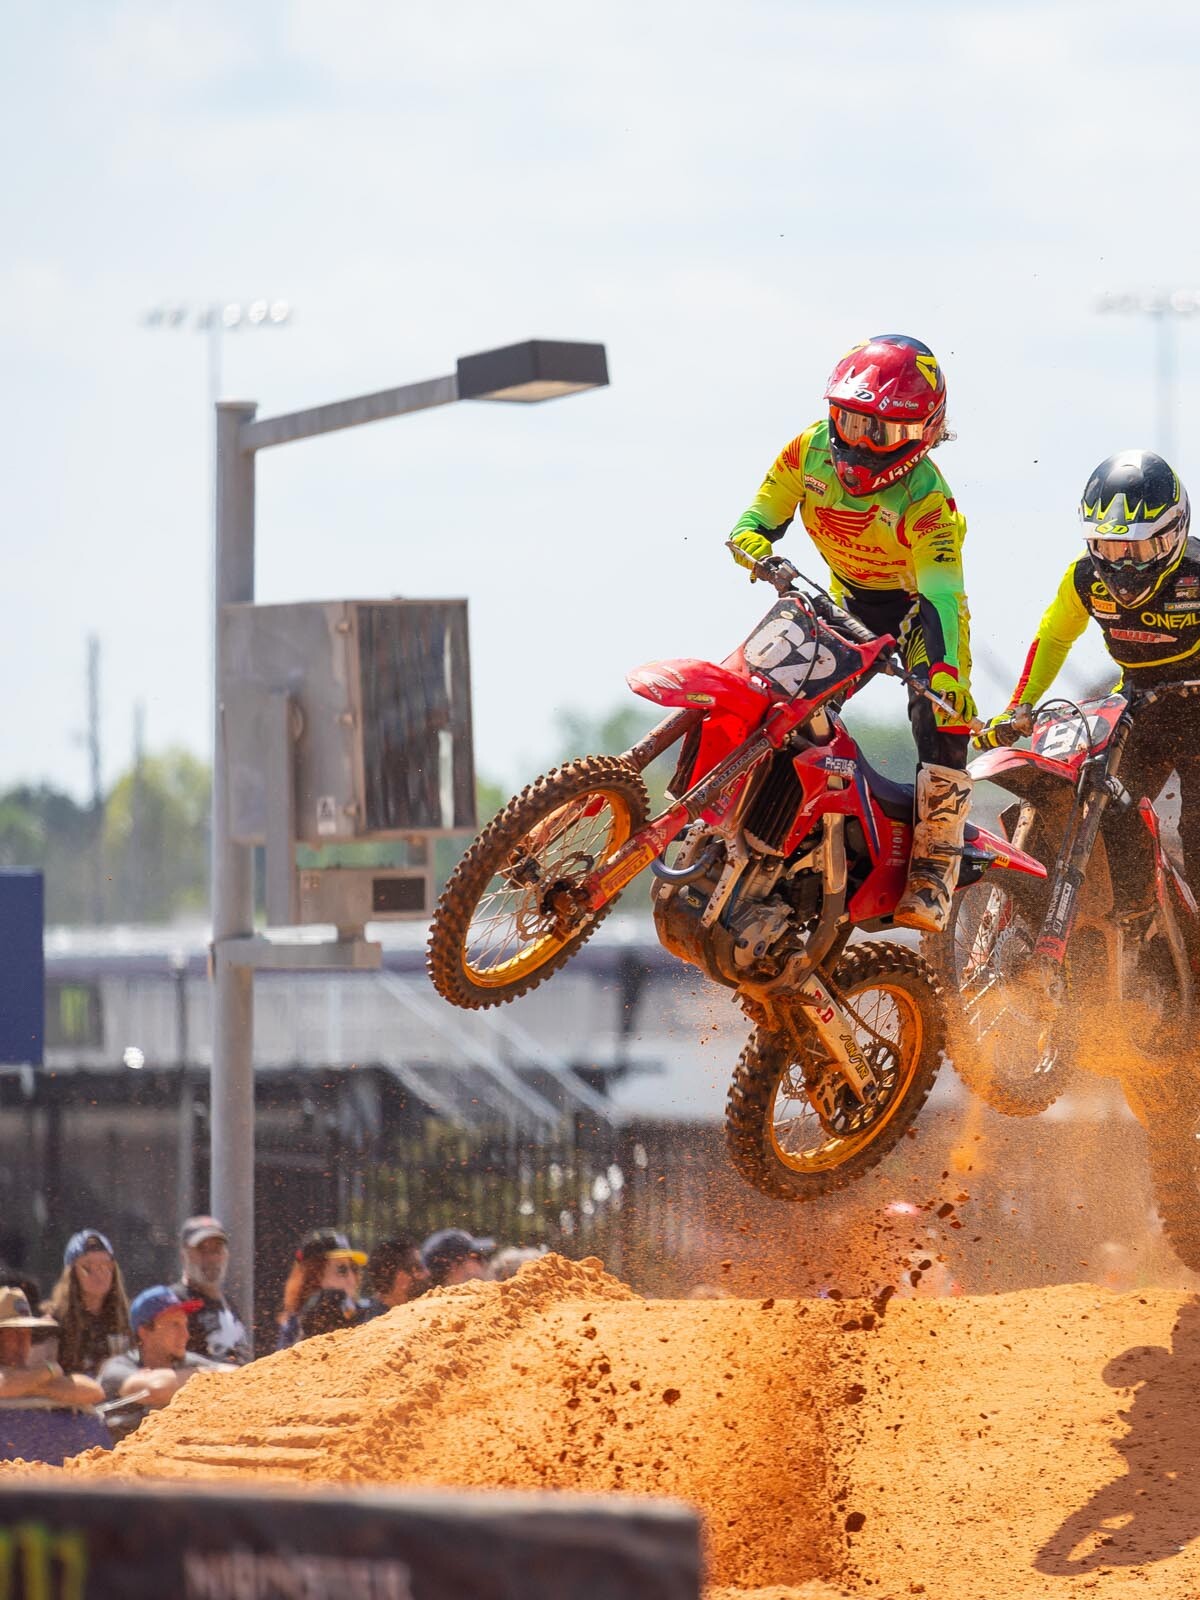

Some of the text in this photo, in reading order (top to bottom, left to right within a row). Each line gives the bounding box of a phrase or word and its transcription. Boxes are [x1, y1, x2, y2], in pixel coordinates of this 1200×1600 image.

[814, 522, 888, 555] HONDA
[917, 522, 956, 539] HONDA
[744, 618, 837, 698] 62
